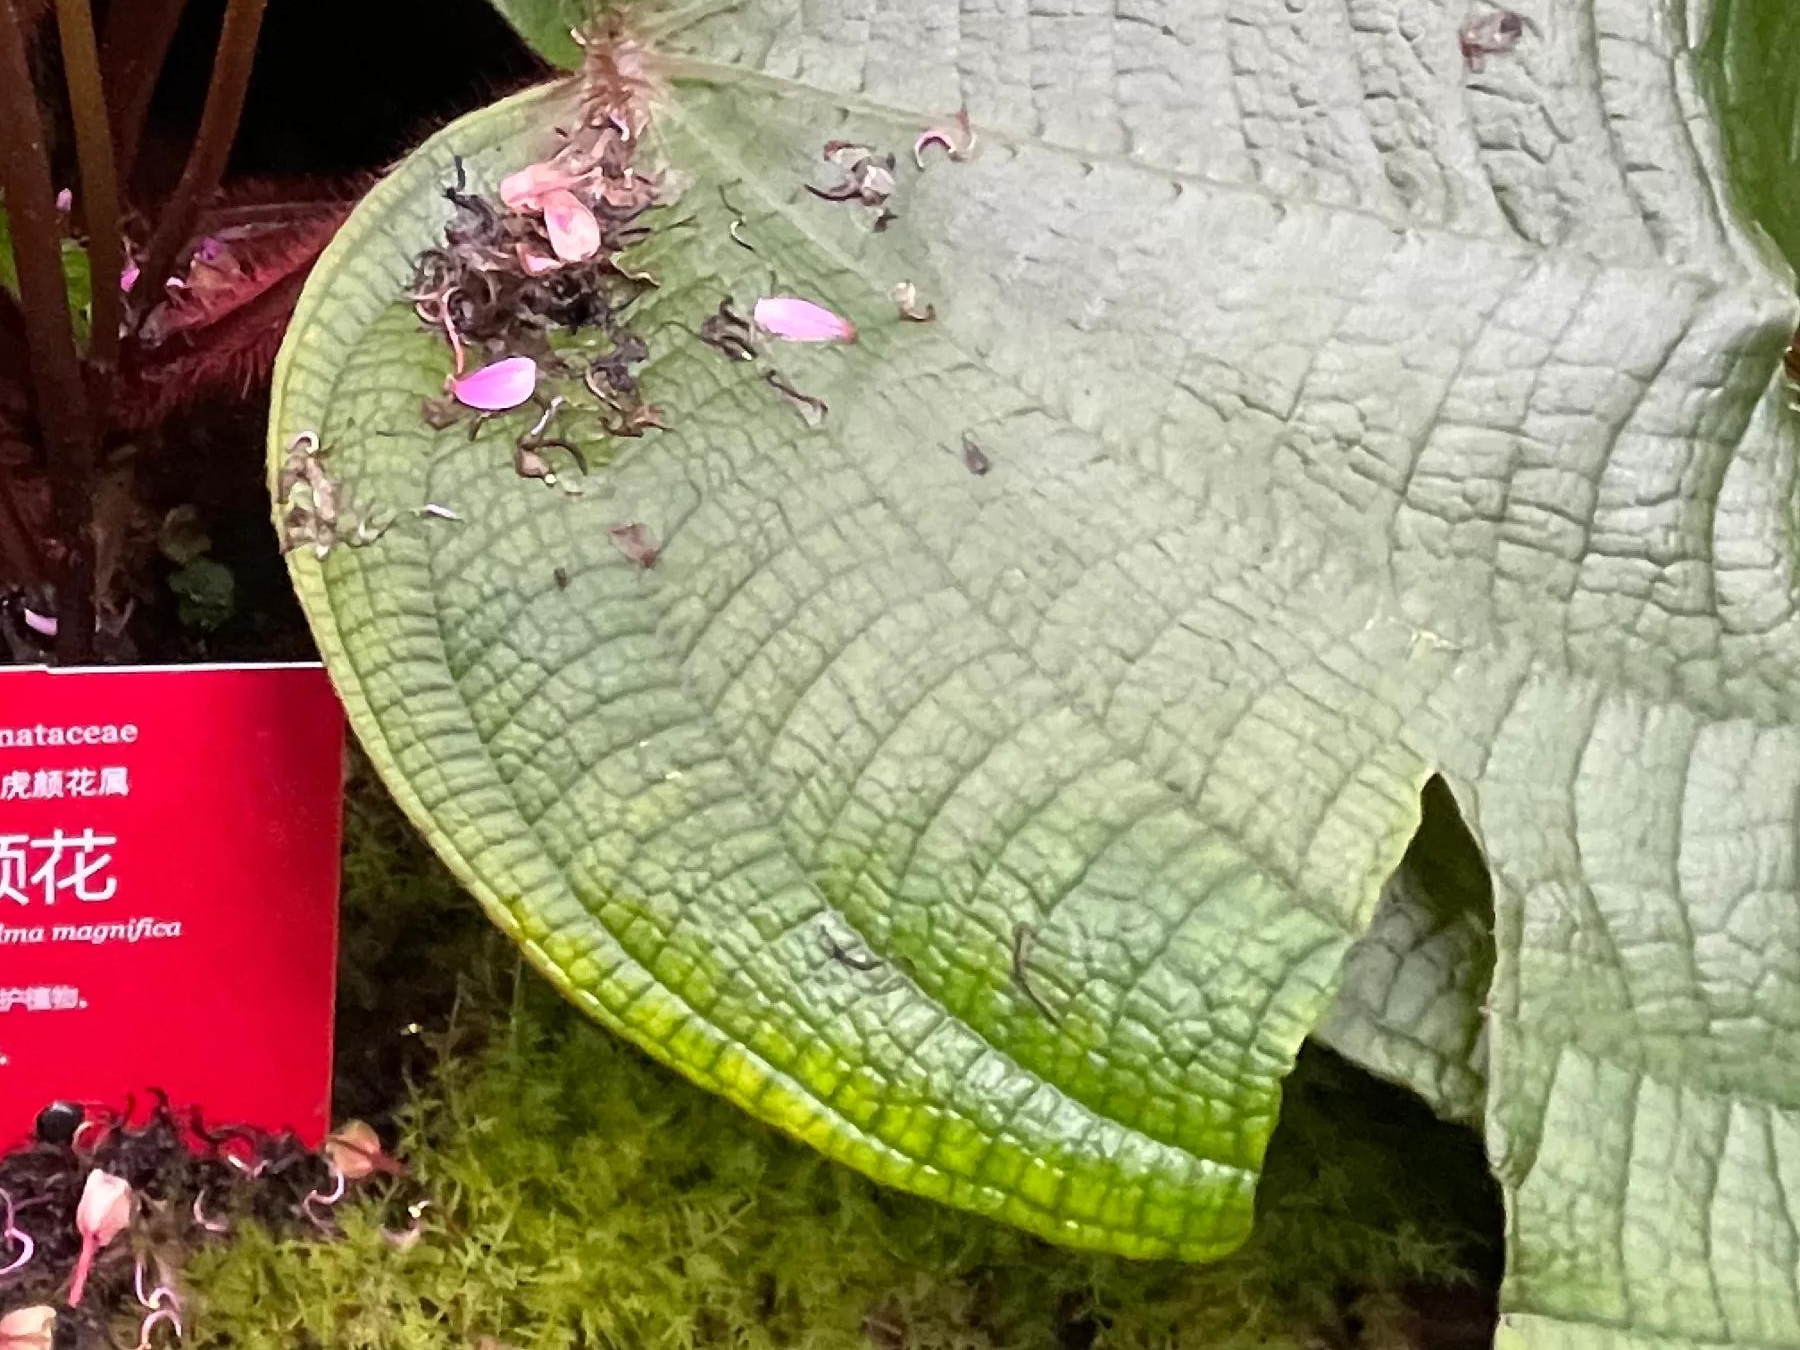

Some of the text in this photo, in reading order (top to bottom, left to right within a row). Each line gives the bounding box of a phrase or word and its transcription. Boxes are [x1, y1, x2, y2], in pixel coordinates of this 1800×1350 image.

[0, 766, 129, 800] 虎颜花属
[52, 917, 182, 944] magnifica
